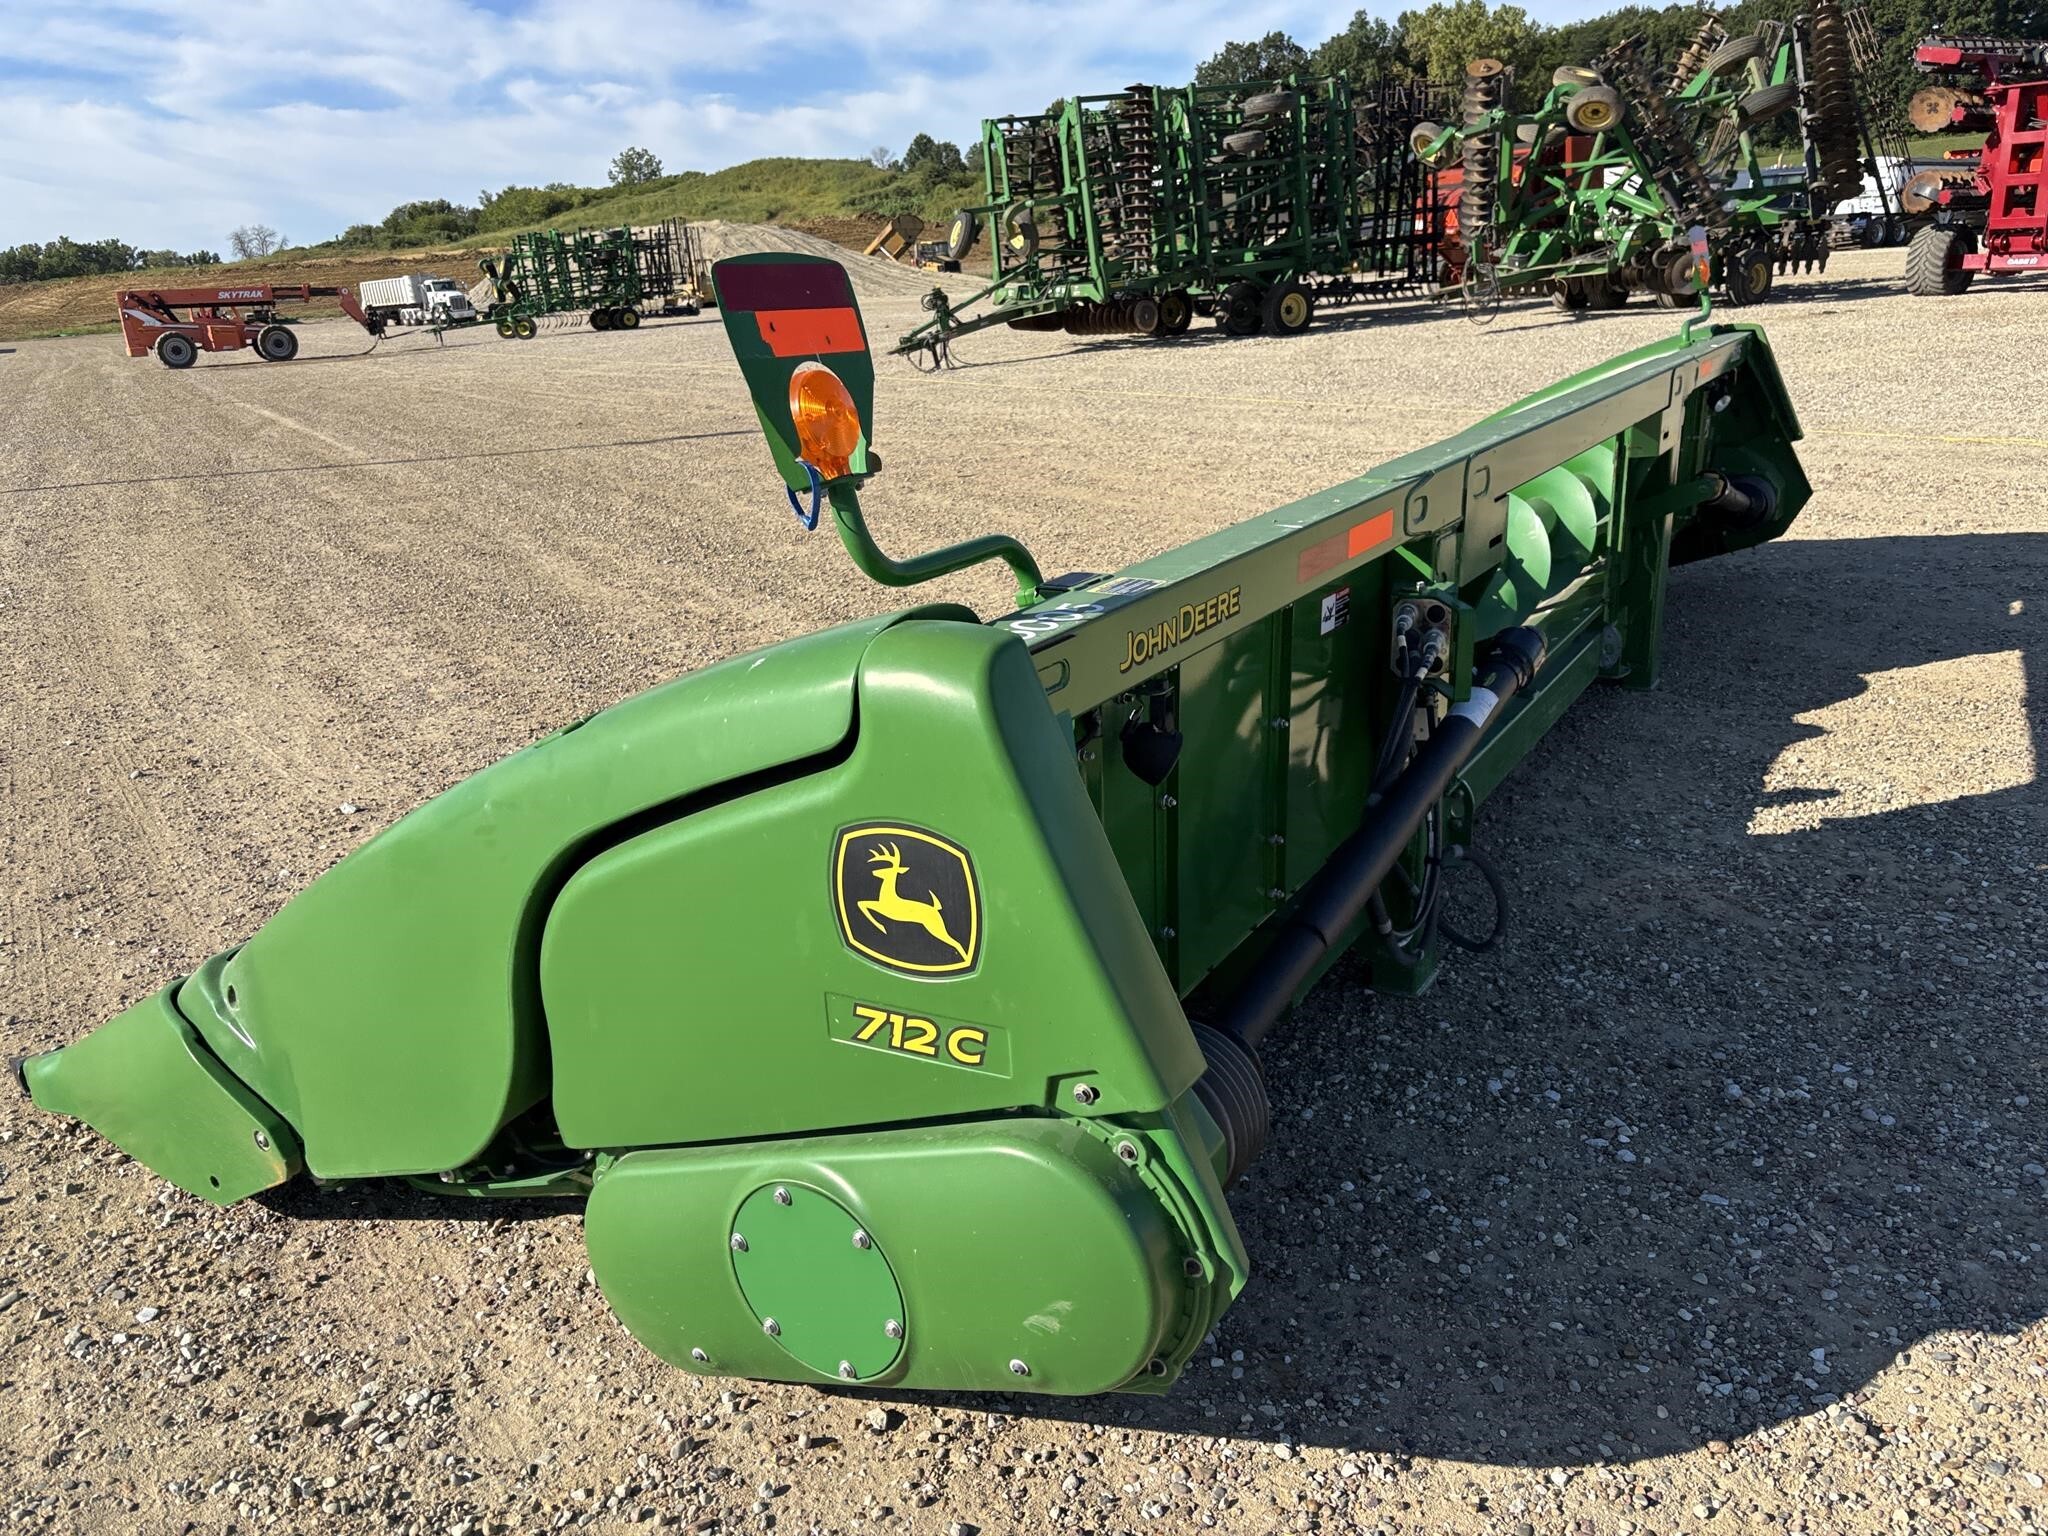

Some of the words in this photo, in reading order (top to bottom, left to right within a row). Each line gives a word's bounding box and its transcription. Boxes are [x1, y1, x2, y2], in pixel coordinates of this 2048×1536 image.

[217, 290, 264, 299] SKYTRAK
[1119, 616, 1178, 673] JOHN
[1179, 585, 1241, 643] DEERE
[853, 1002, 940, 1058] 712
[945, 1025, 989, 1066] C
